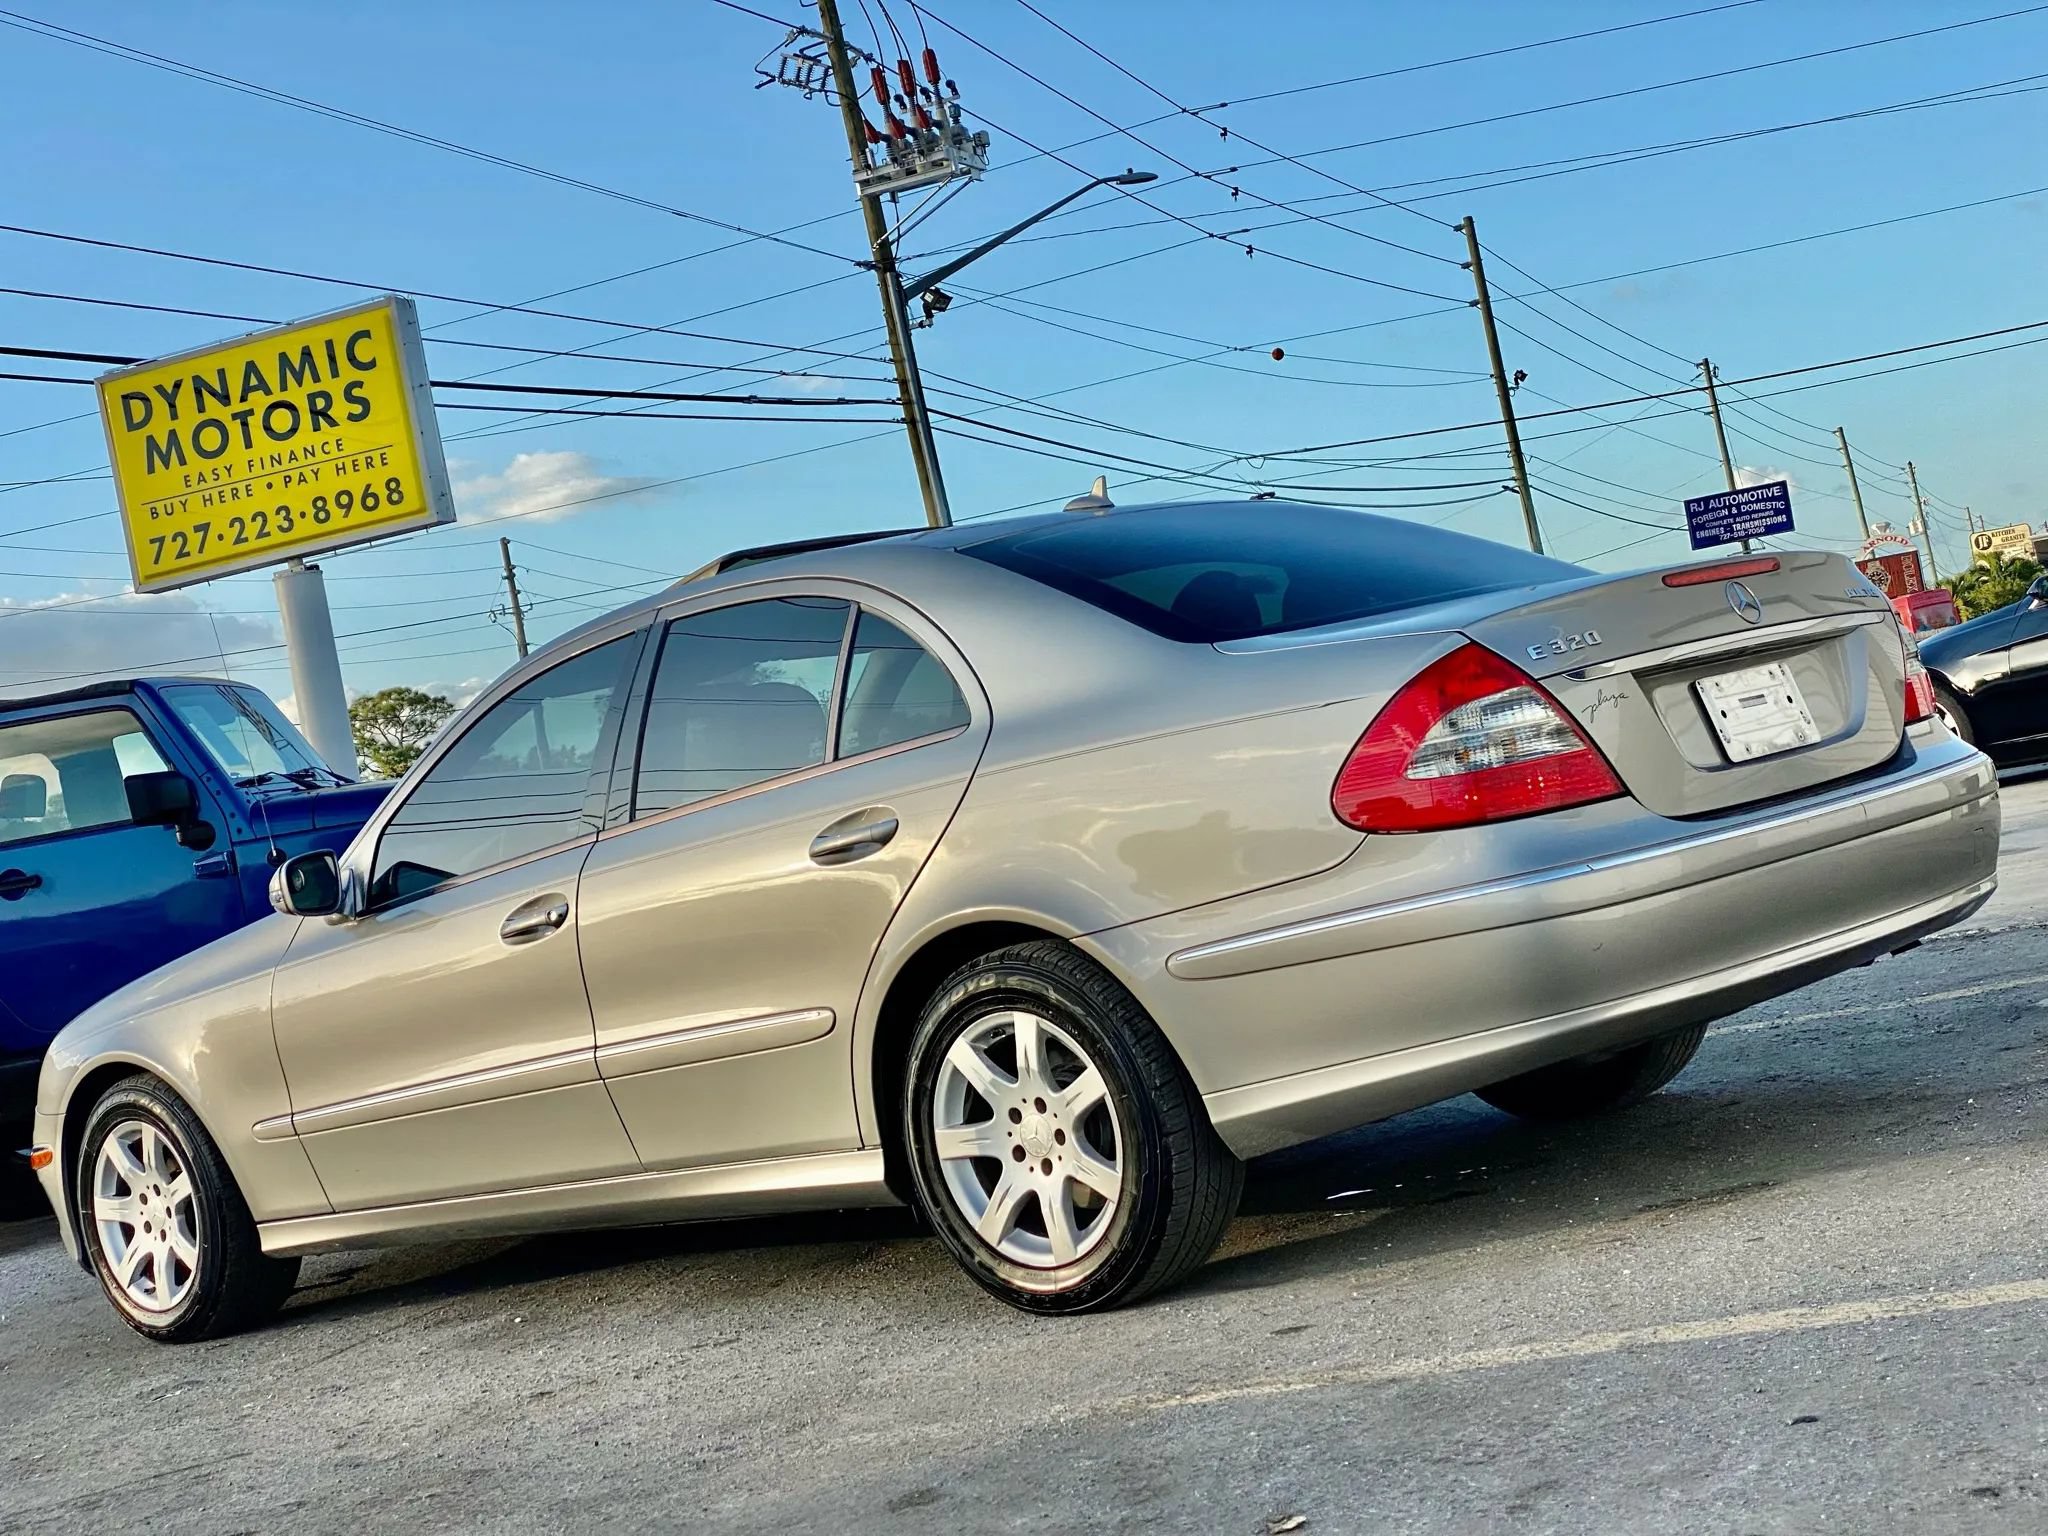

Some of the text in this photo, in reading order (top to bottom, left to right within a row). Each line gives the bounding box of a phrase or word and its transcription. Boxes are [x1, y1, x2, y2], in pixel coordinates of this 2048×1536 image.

[121, 329, 377, 432] DYNAMIC
[146, 380, 371, 475] MOTORS
[183, 438, 345, 488] EASY FINANCE
[150, 452, 390, 521] BUY HERE PAY HERE
[1690, 486, 1782, 513] RJ AUTOMOTIVE
[1692, 509, 1728, 526] FOREIGN
[1740, 501, 1785, 512] DOMESTIC
[1732, 514, 1787, 532] TRANSMISSIONS
[1863, 535, 1909, 553] ARNOLD
[1991, 528, 2016, 538] KITCHEN
[2001, 533, 2026, 543] GRANITE
[1526, 629, 1603, 661] E 320
[1581, 688, 1630, 724] plaza
